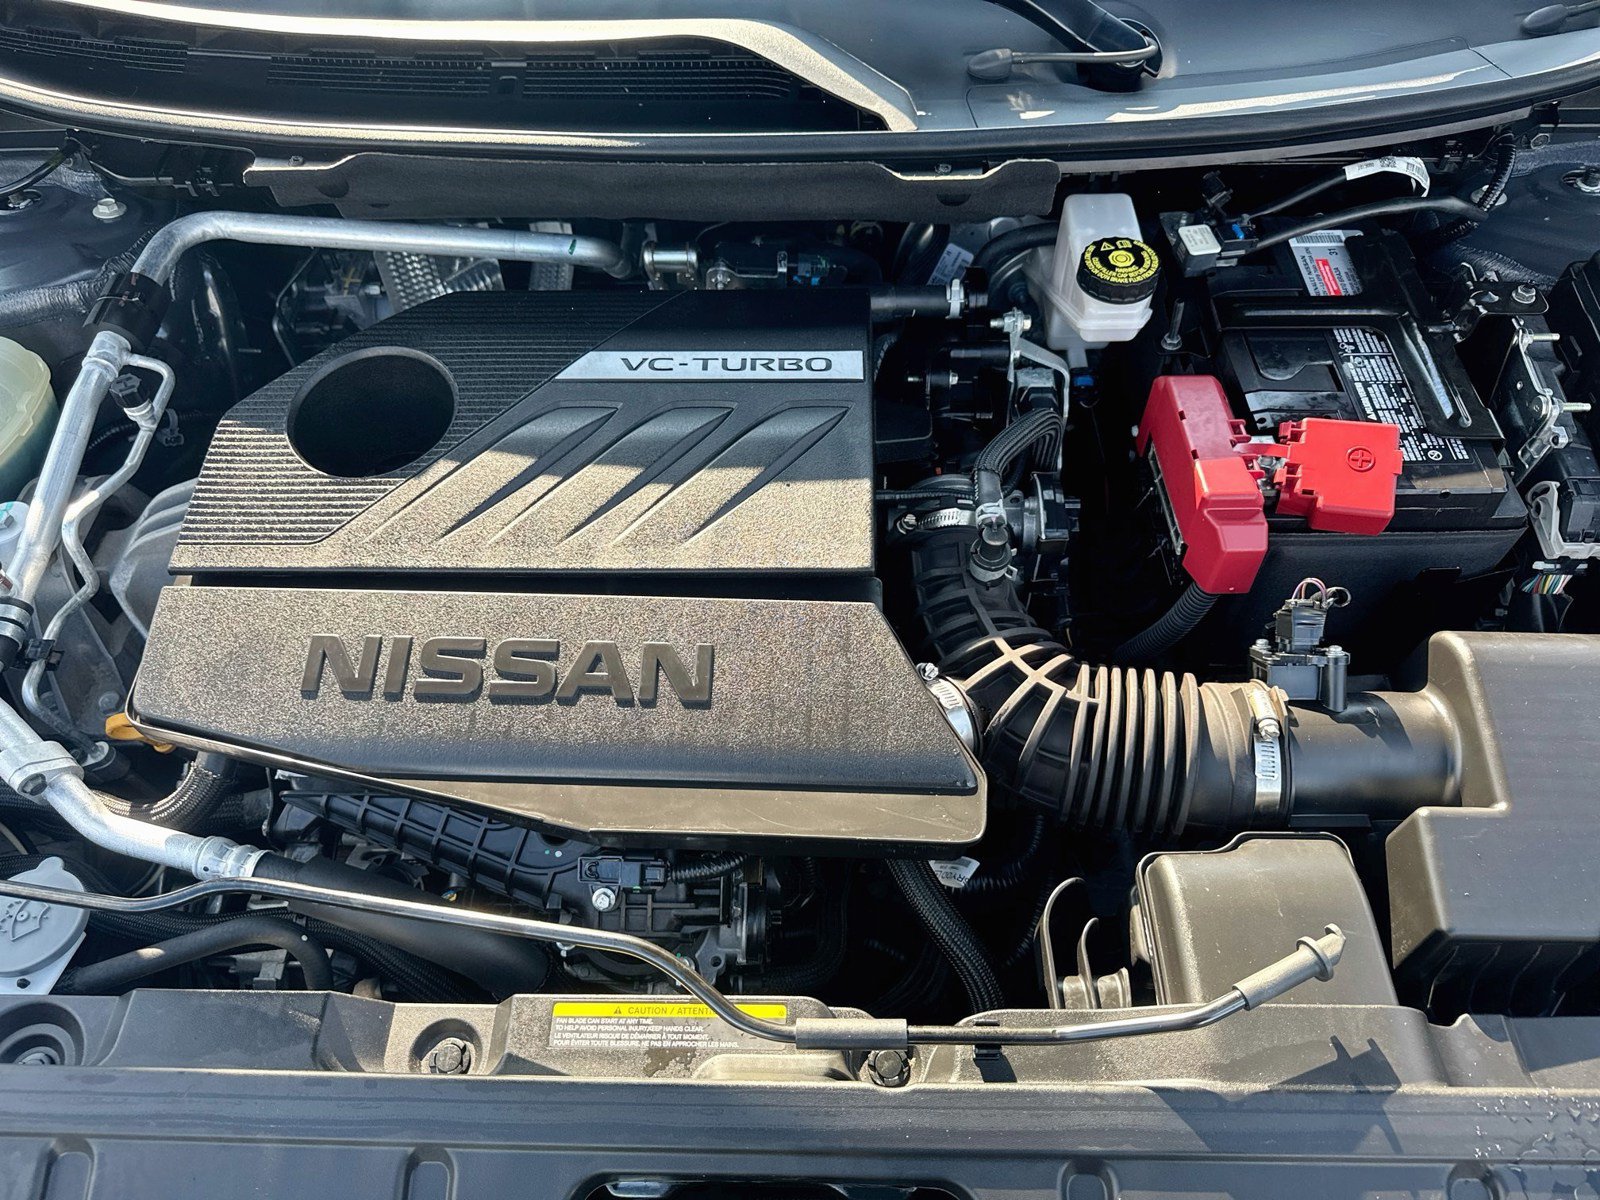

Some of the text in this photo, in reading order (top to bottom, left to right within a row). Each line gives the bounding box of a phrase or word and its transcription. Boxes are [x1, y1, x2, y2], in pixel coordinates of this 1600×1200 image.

[1328, 248, 1338, 256] 31
[621, 357, 832, 371] VC-TURBO
[300, 634, 713, 705] NISSAN
[628, 1007, 667, 1015] CAUTION
